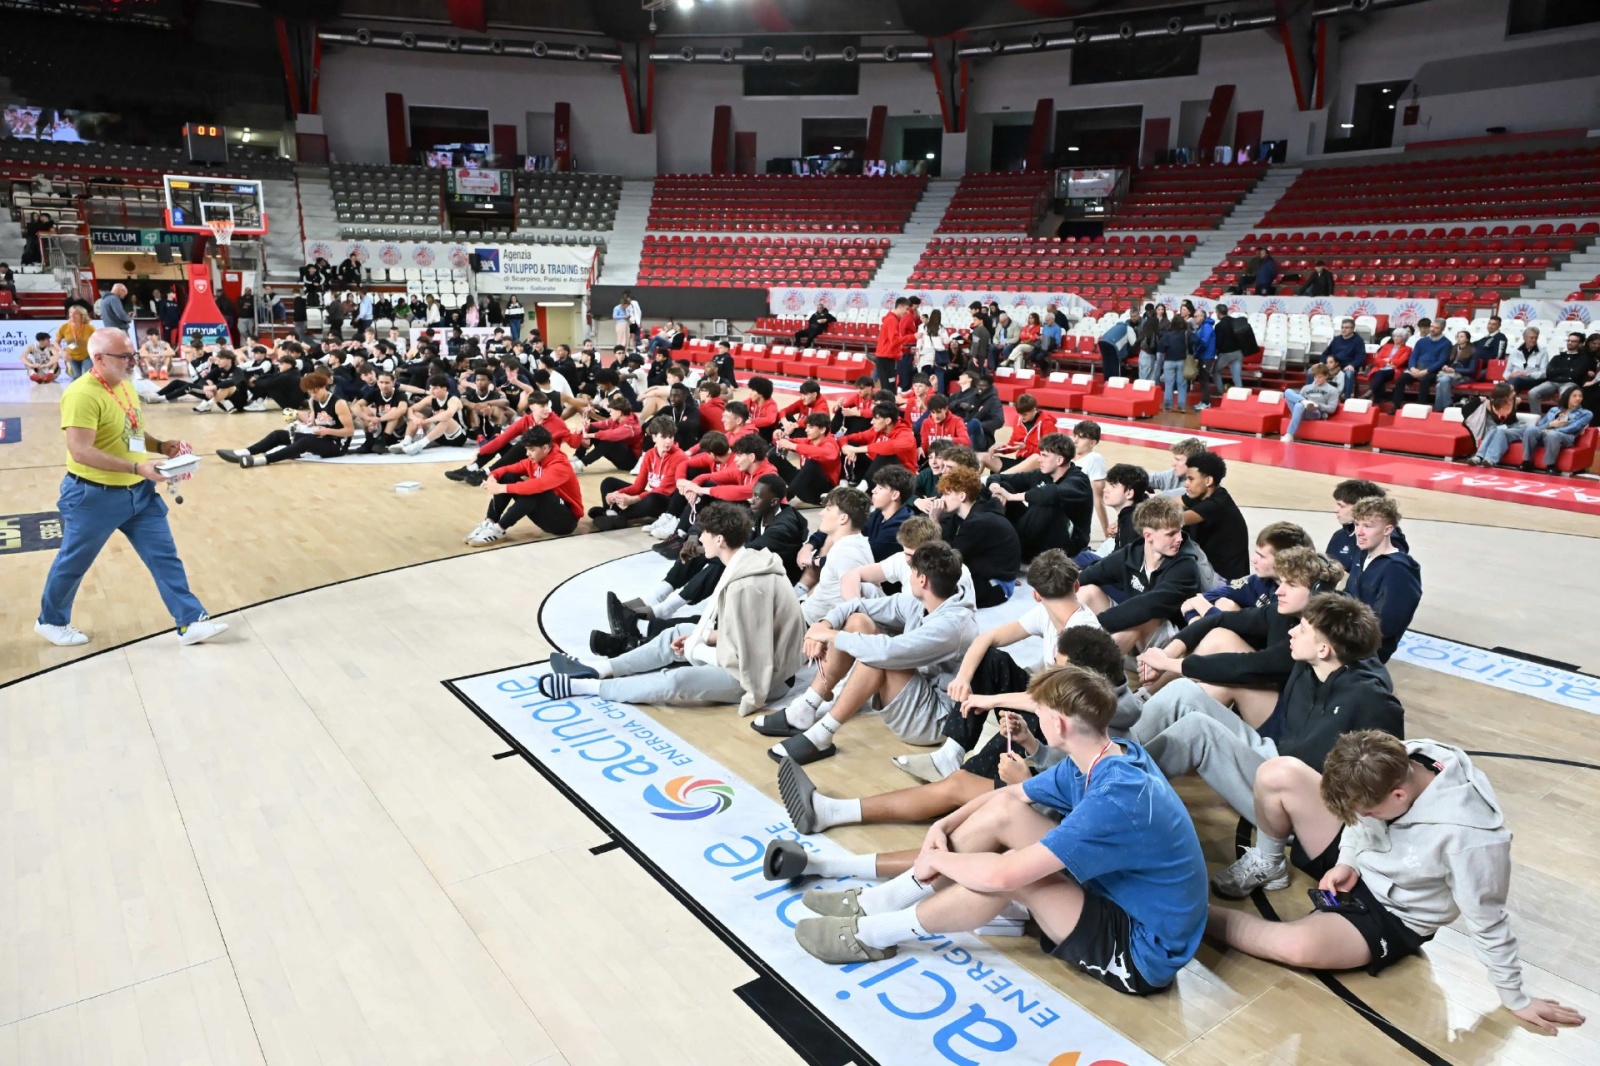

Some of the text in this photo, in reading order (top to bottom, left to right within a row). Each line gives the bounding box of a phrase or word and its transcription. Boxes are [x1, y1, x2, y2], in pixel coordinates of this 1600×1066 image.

[92, 232, 136, 242] ITELYUM
[502, 249, 532, 260] Agenzia
[503, 263, 538, 274] SVILUPPO
[540, 264, 546, 275] &
[547, 264, 578, 275] TRADING
[1501, 658, 1600, 688] NERGIA
[622, 719, 693, 766] ENERGIA
